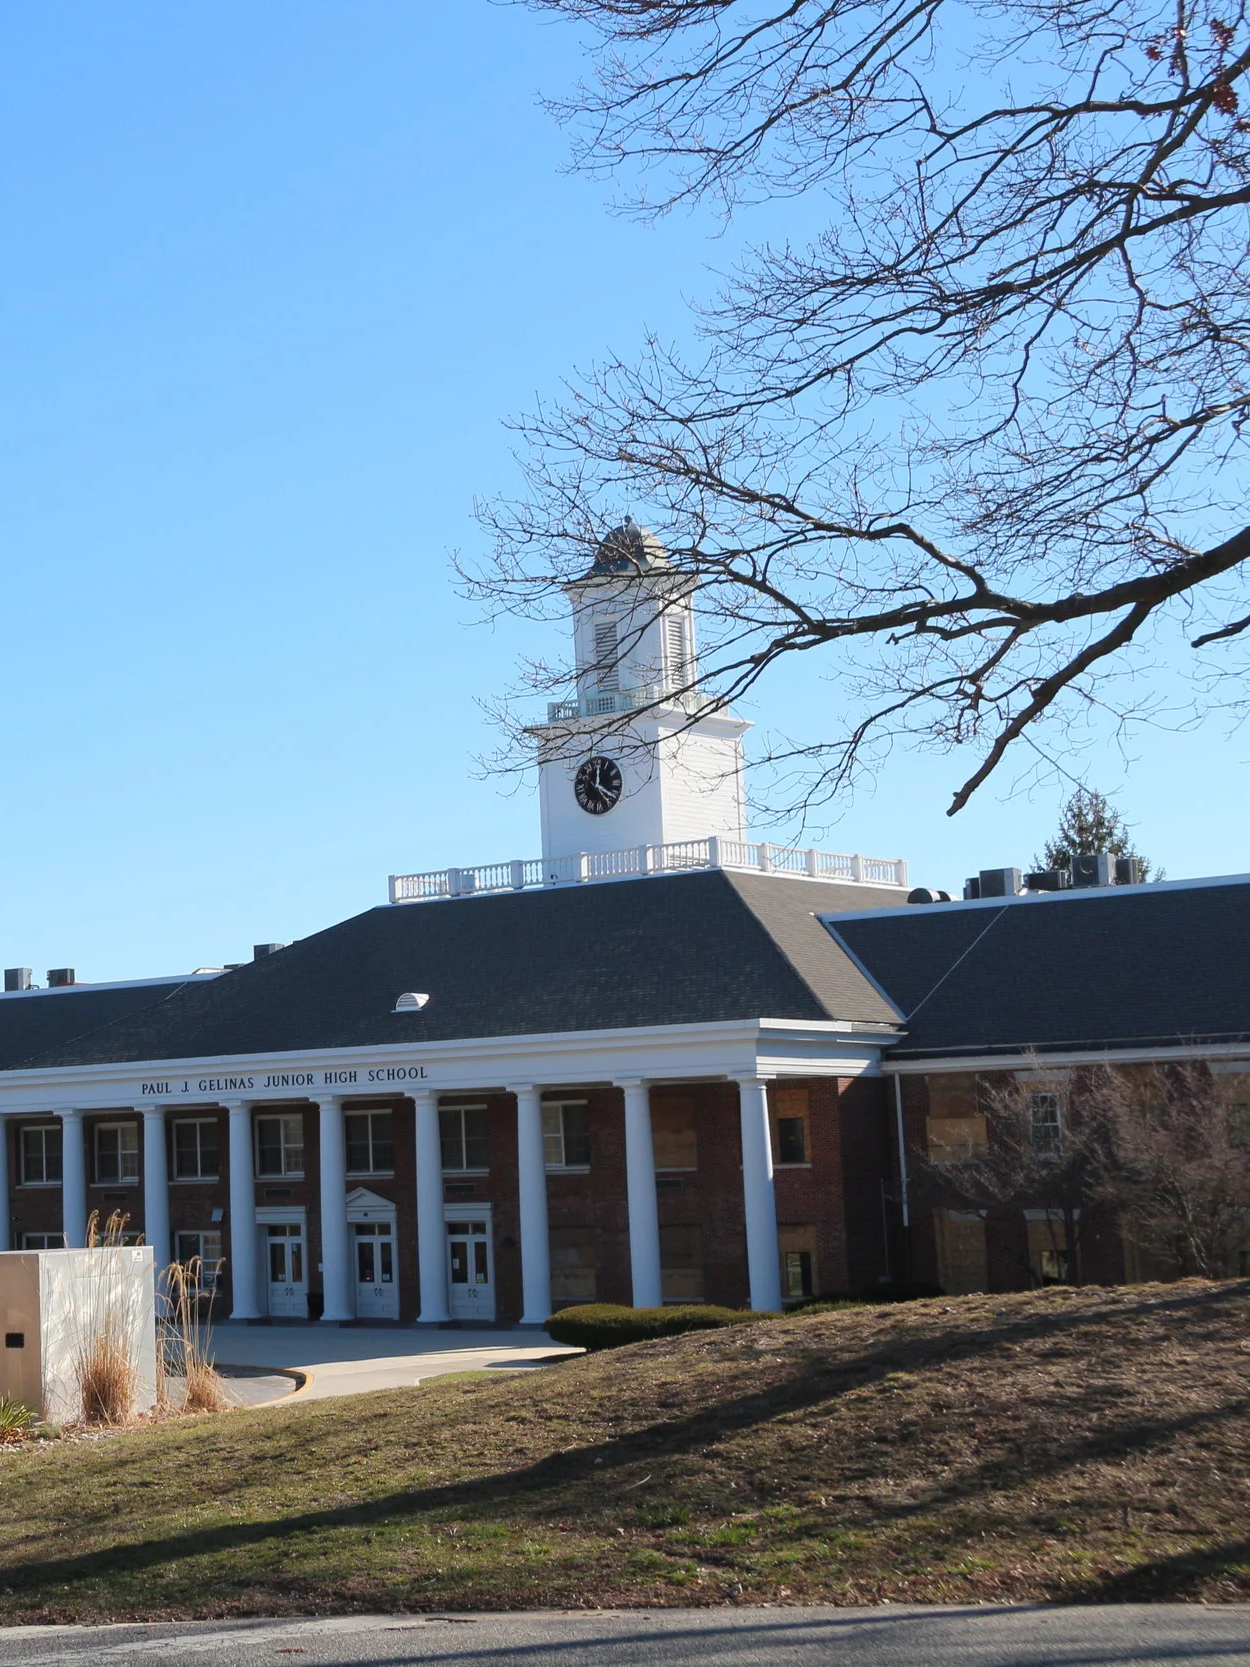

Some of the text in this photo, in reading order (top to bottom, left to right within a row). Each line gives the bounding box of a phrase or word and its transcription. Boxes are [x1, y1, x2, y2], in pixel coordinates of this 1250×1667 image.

[141, 1066, 428, 1095] PAUL J. GELINAS JUNIOR HIGH SCHOOL
